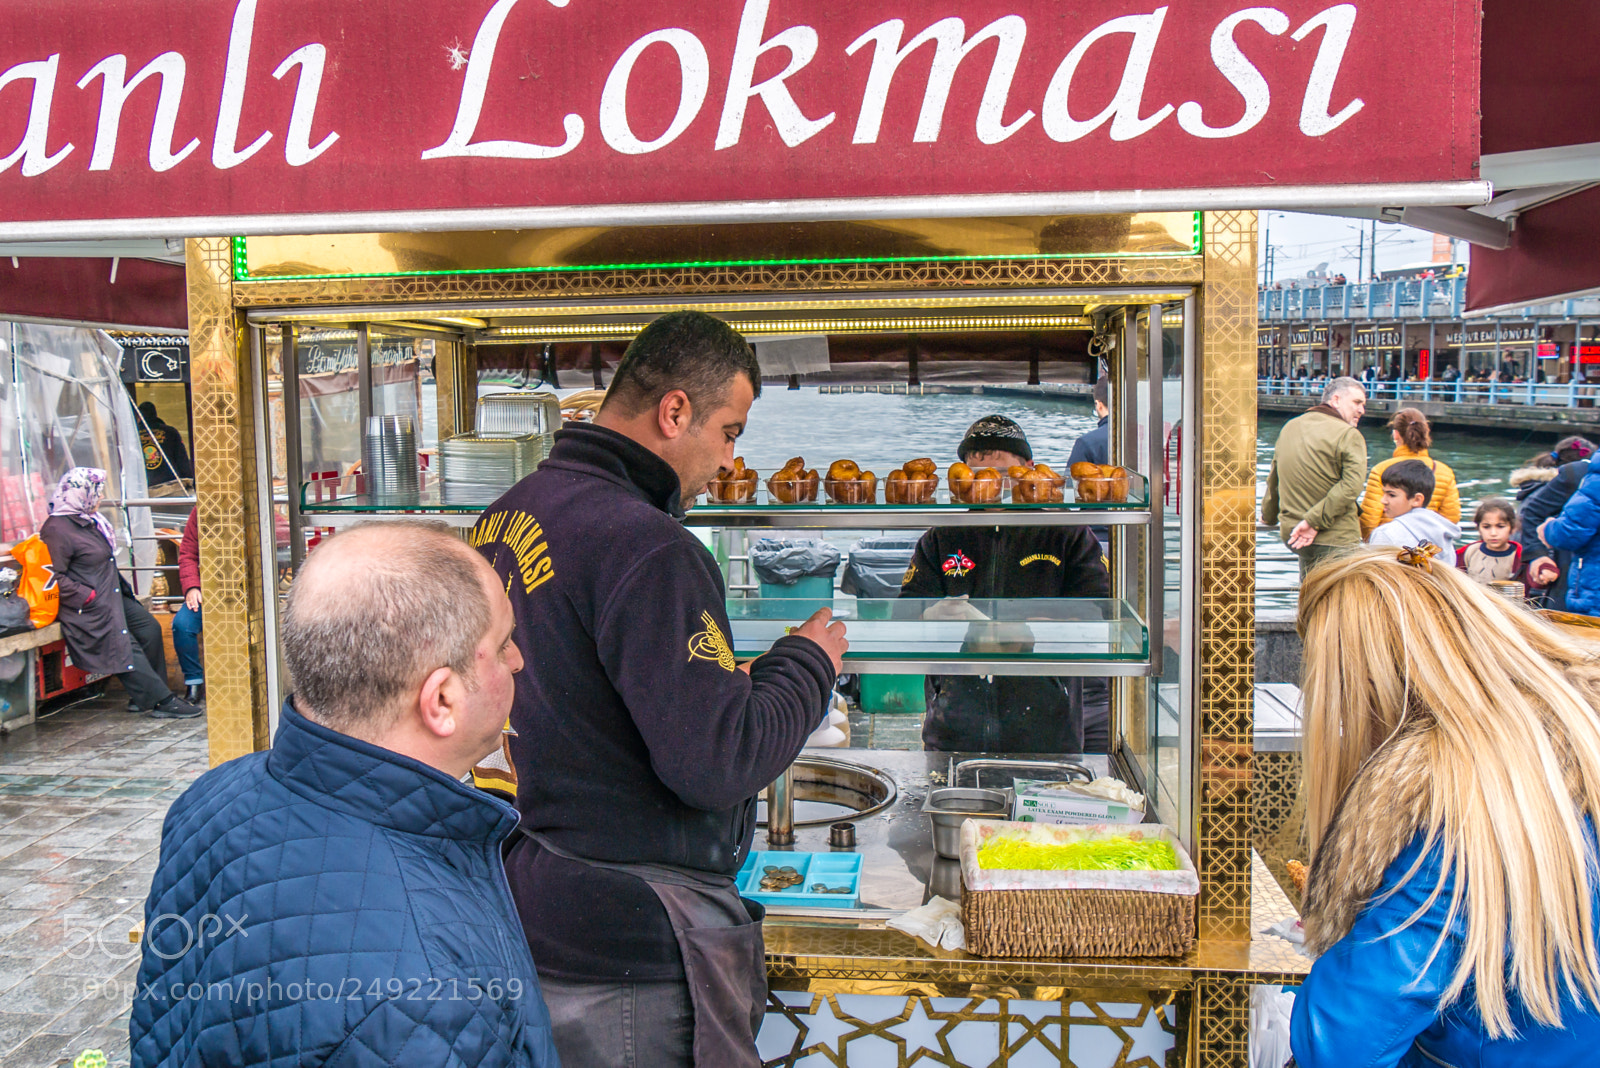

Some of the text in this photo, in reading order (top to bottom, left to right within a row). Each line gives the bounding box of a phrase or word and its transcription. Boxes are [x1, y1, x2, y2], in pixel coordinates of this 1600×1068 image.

[420, 0, 1365, 159] Lokması
[502, 510, 555, 595] LOKMASI
[1064, 810, 1097, 818] POWDERED
